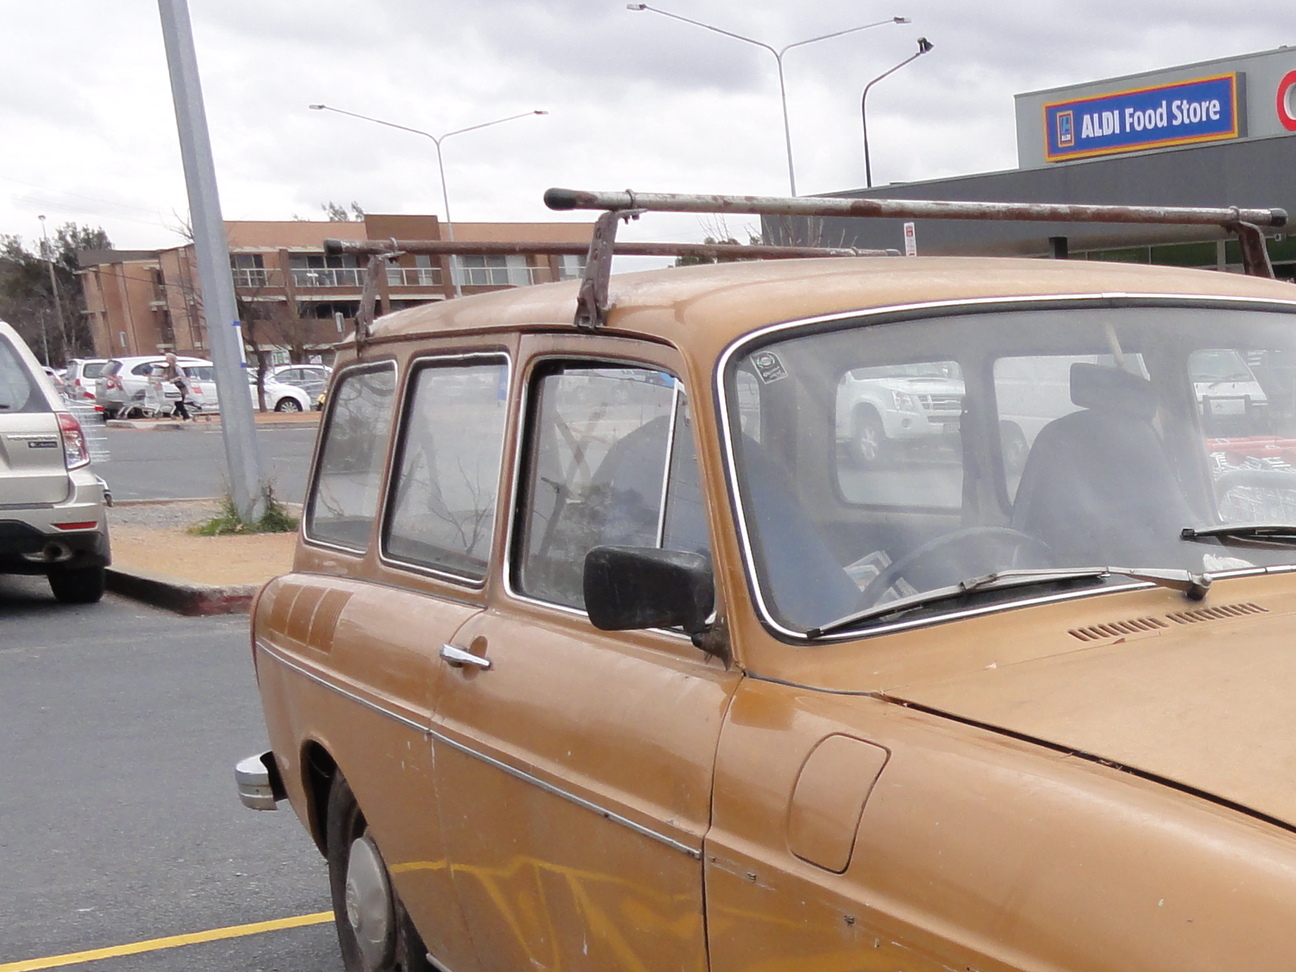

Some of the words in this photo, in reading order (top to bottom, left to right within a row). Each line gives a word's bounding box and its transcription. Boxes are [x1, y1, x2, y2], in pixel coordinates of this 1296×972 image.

[1081, 110, 1120, 138] ALDI
[1125, 101, 1167, 133] Food
[1172, 99, 1221, 126] Store
